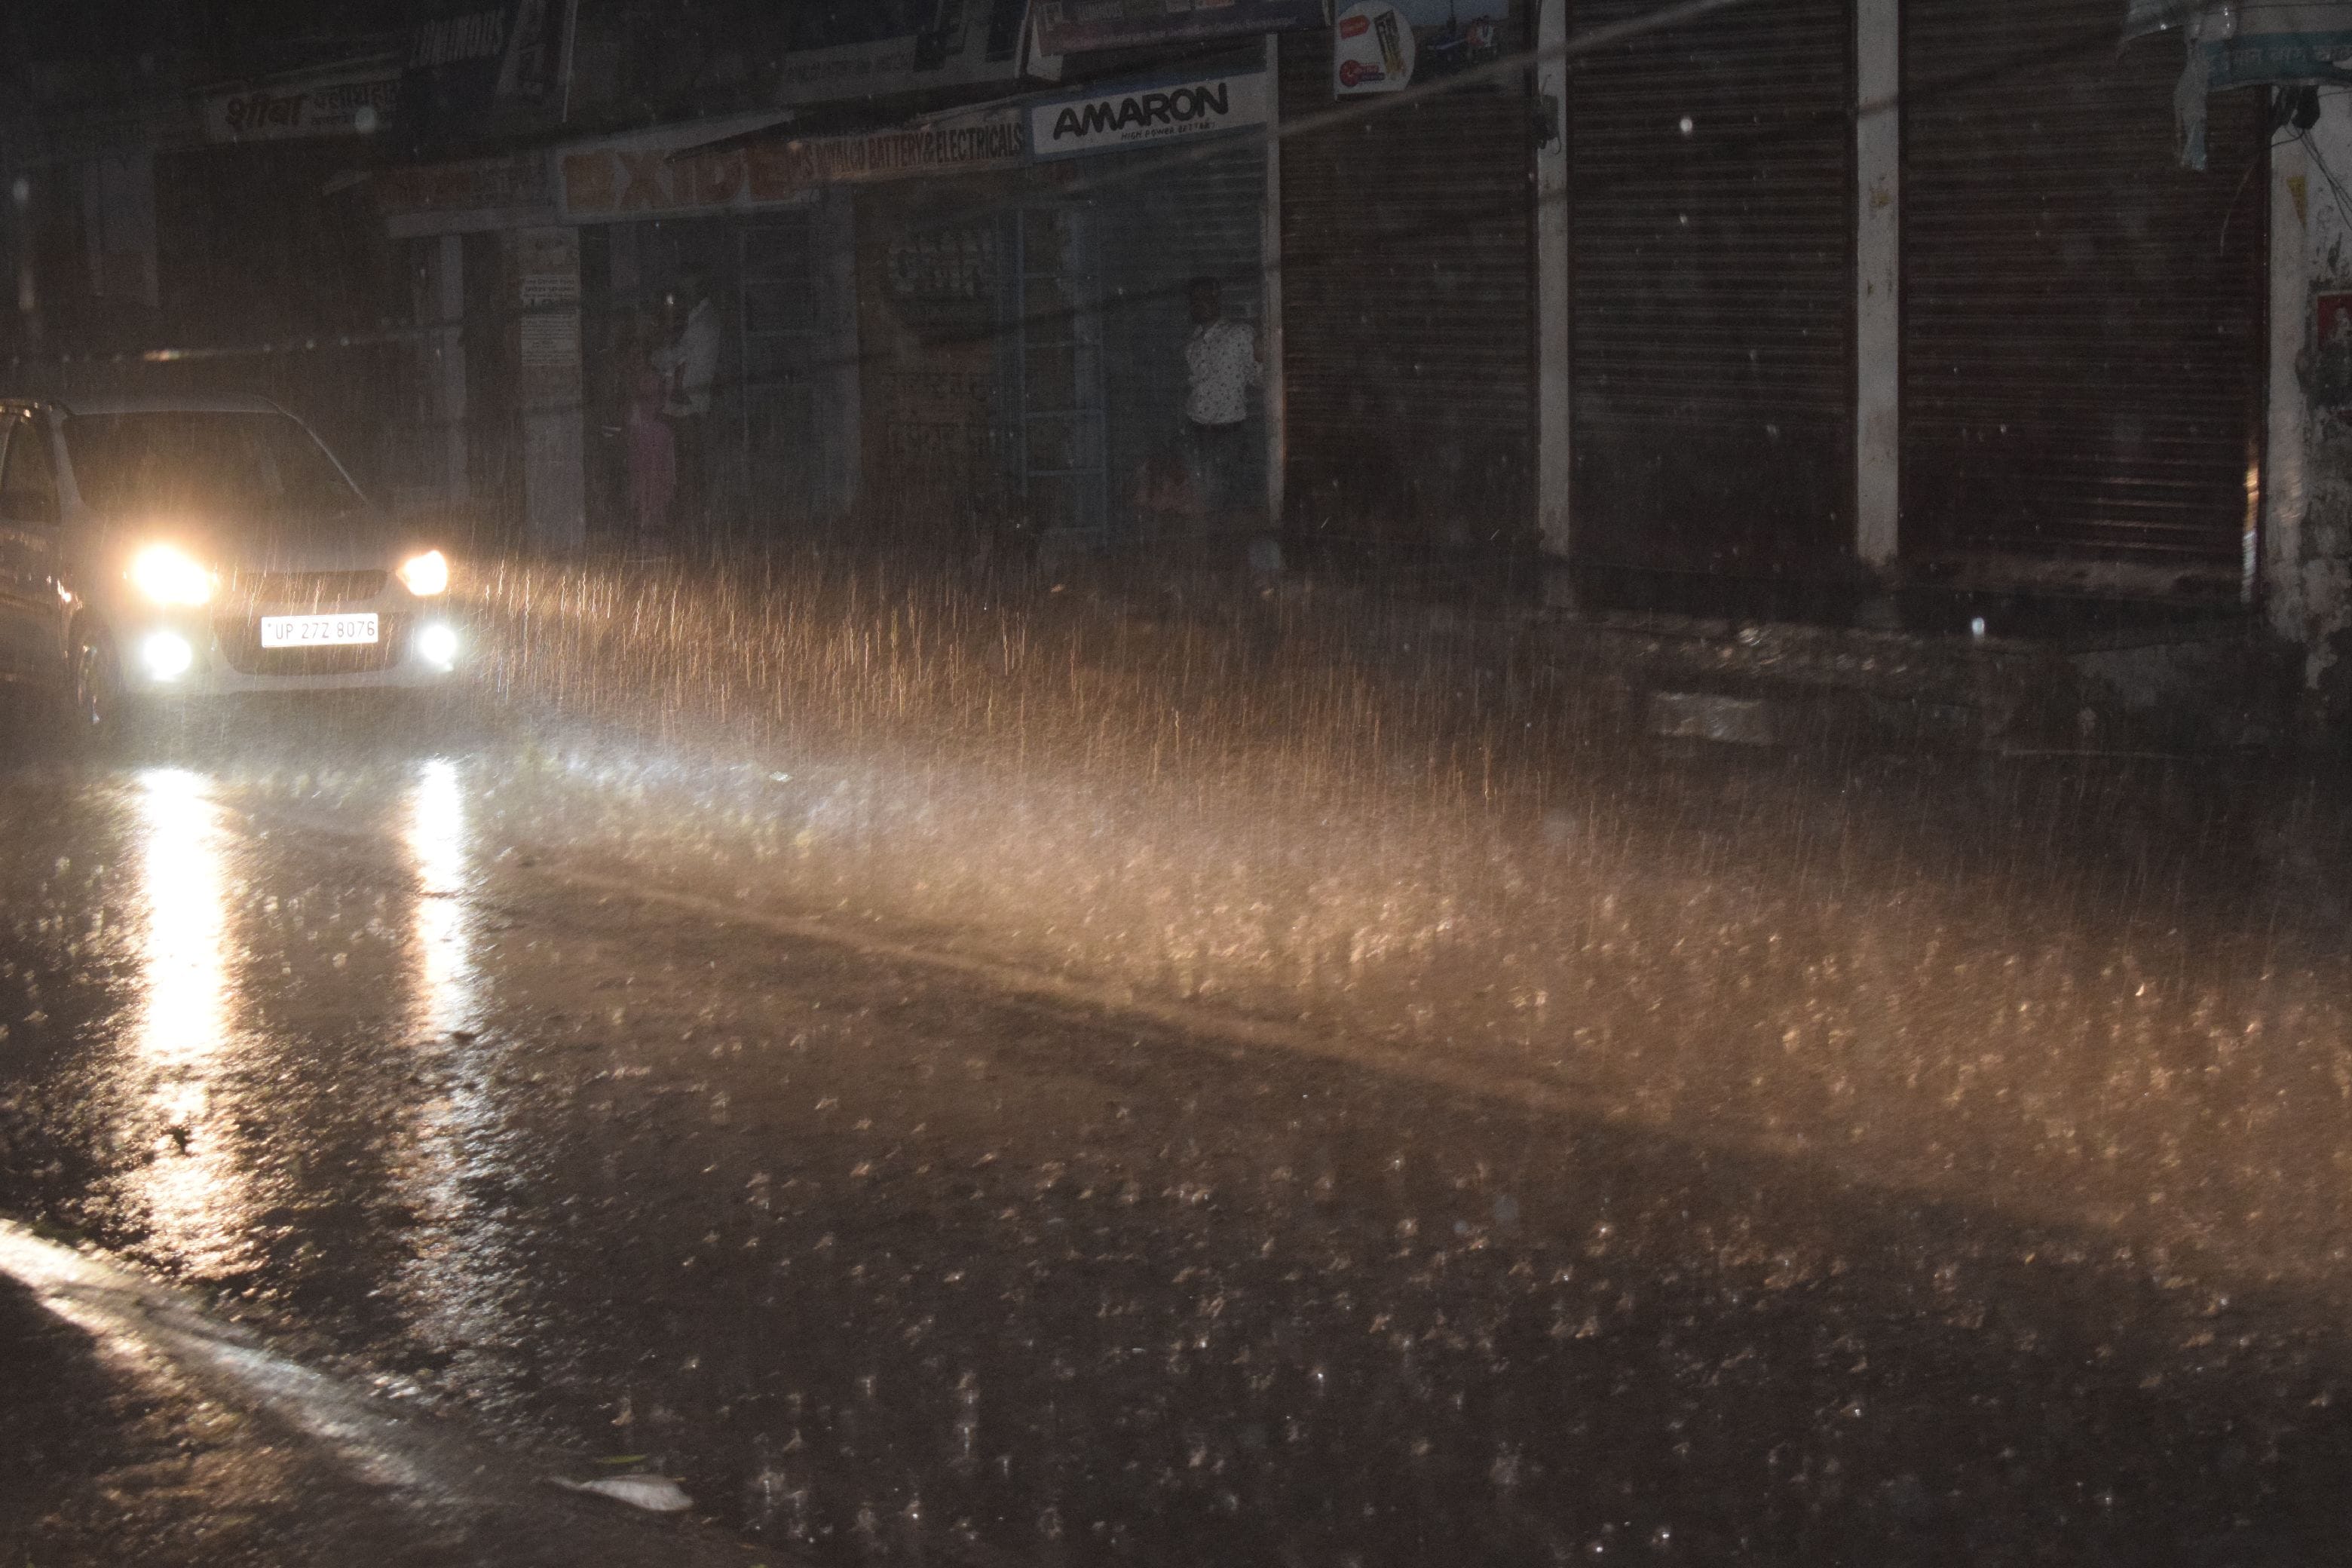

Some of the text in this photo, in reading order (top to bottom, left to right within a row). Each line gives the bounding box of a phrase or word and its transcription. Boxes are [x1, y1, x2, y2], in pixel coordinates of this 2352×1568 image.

[409, 8, 506, 69] LUMINOUS
[1053, 82, 1230, 140] AMARON
[936, 122, 1024, 164] ELECTRICALS
[563, 143, 790, 213] EXIDE
[275, 623, 295, 640] UP
[336, 620, 375, 637] 8076
